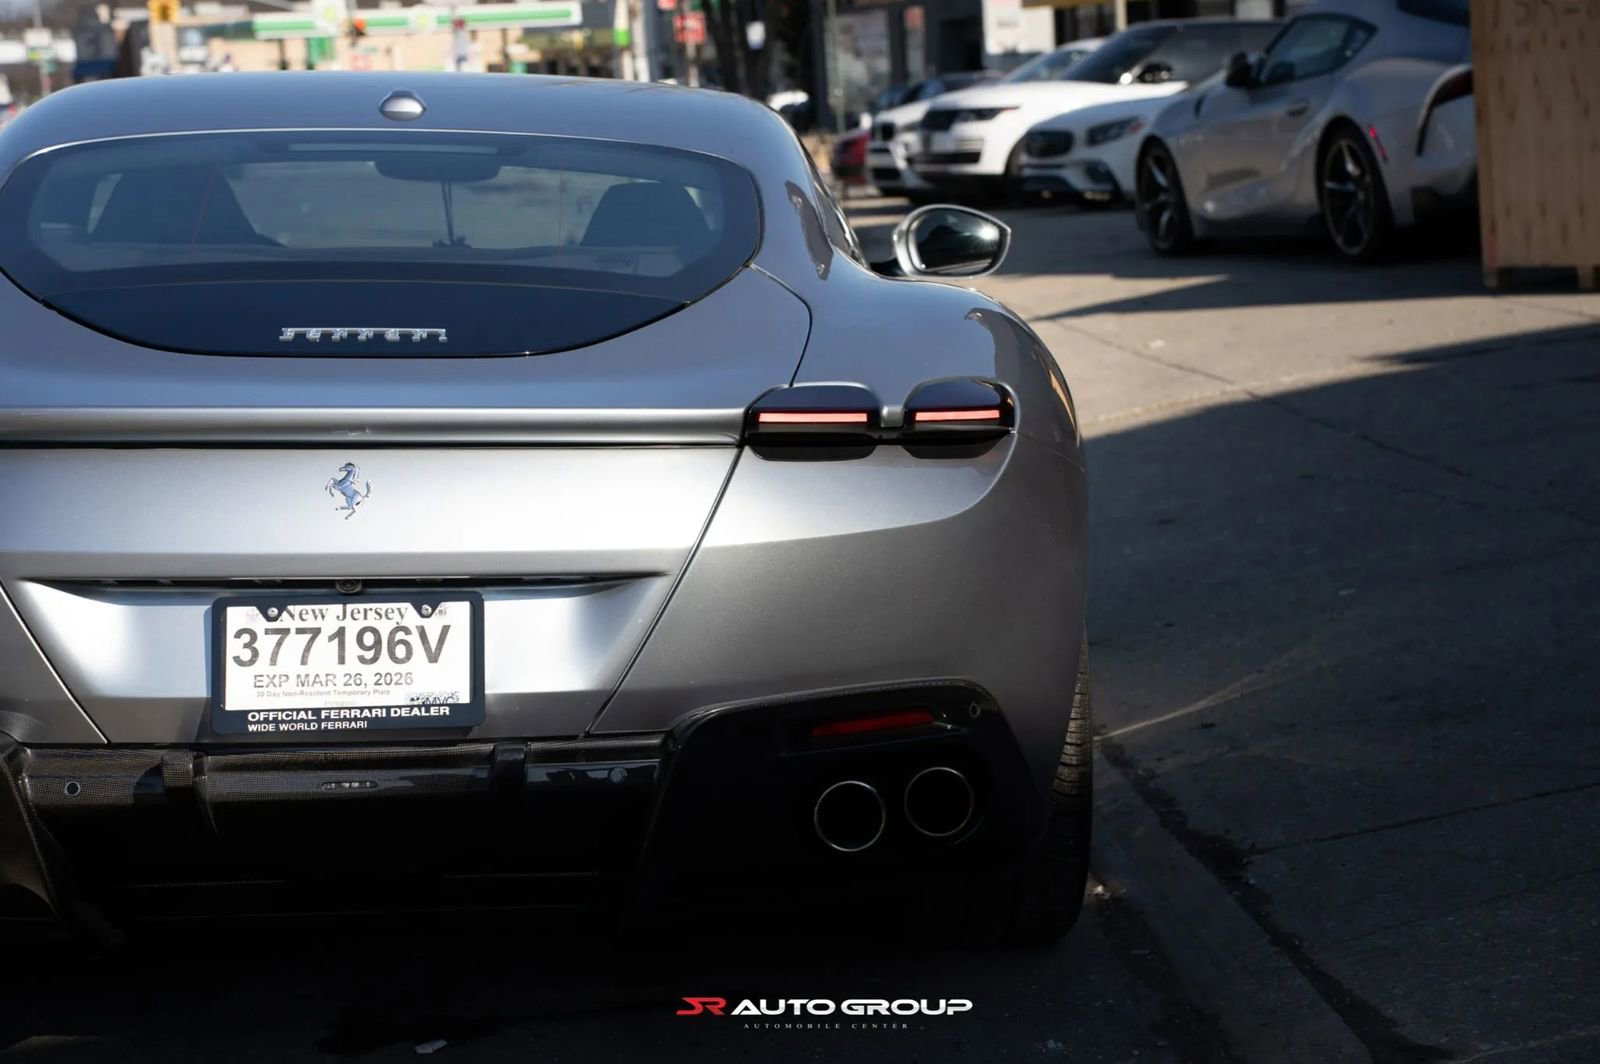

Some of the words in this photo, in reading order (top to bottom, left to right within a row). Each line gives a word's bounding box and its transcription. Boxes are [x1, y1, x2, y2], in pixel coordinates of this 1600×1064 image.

[279, 327, 448, 342] Ferrari
[280, 605, 328, 622] New
[336, 604, 408, 625] Jersey
[232, 625, 451, 667] 377196V
[253, 674, 289, 688] EXP
[296, 673, 337, 687] MAR
[343, 673, 368, 688] 26,
[373, 672, 413, 686] 2026
[267, 690, 281, 698] Day
[333, 689, 371, 698] Temporary
[248, 710, 317, 722] OFFICIAL
[321, 708, 386, 719] FERRARI
[390, 706, 450, 717] DEALER
[248, 723, 276, 732] WIDE
[279, 722, 318, 731] WORLD
[321, 720, 367, 730] FERRARI
